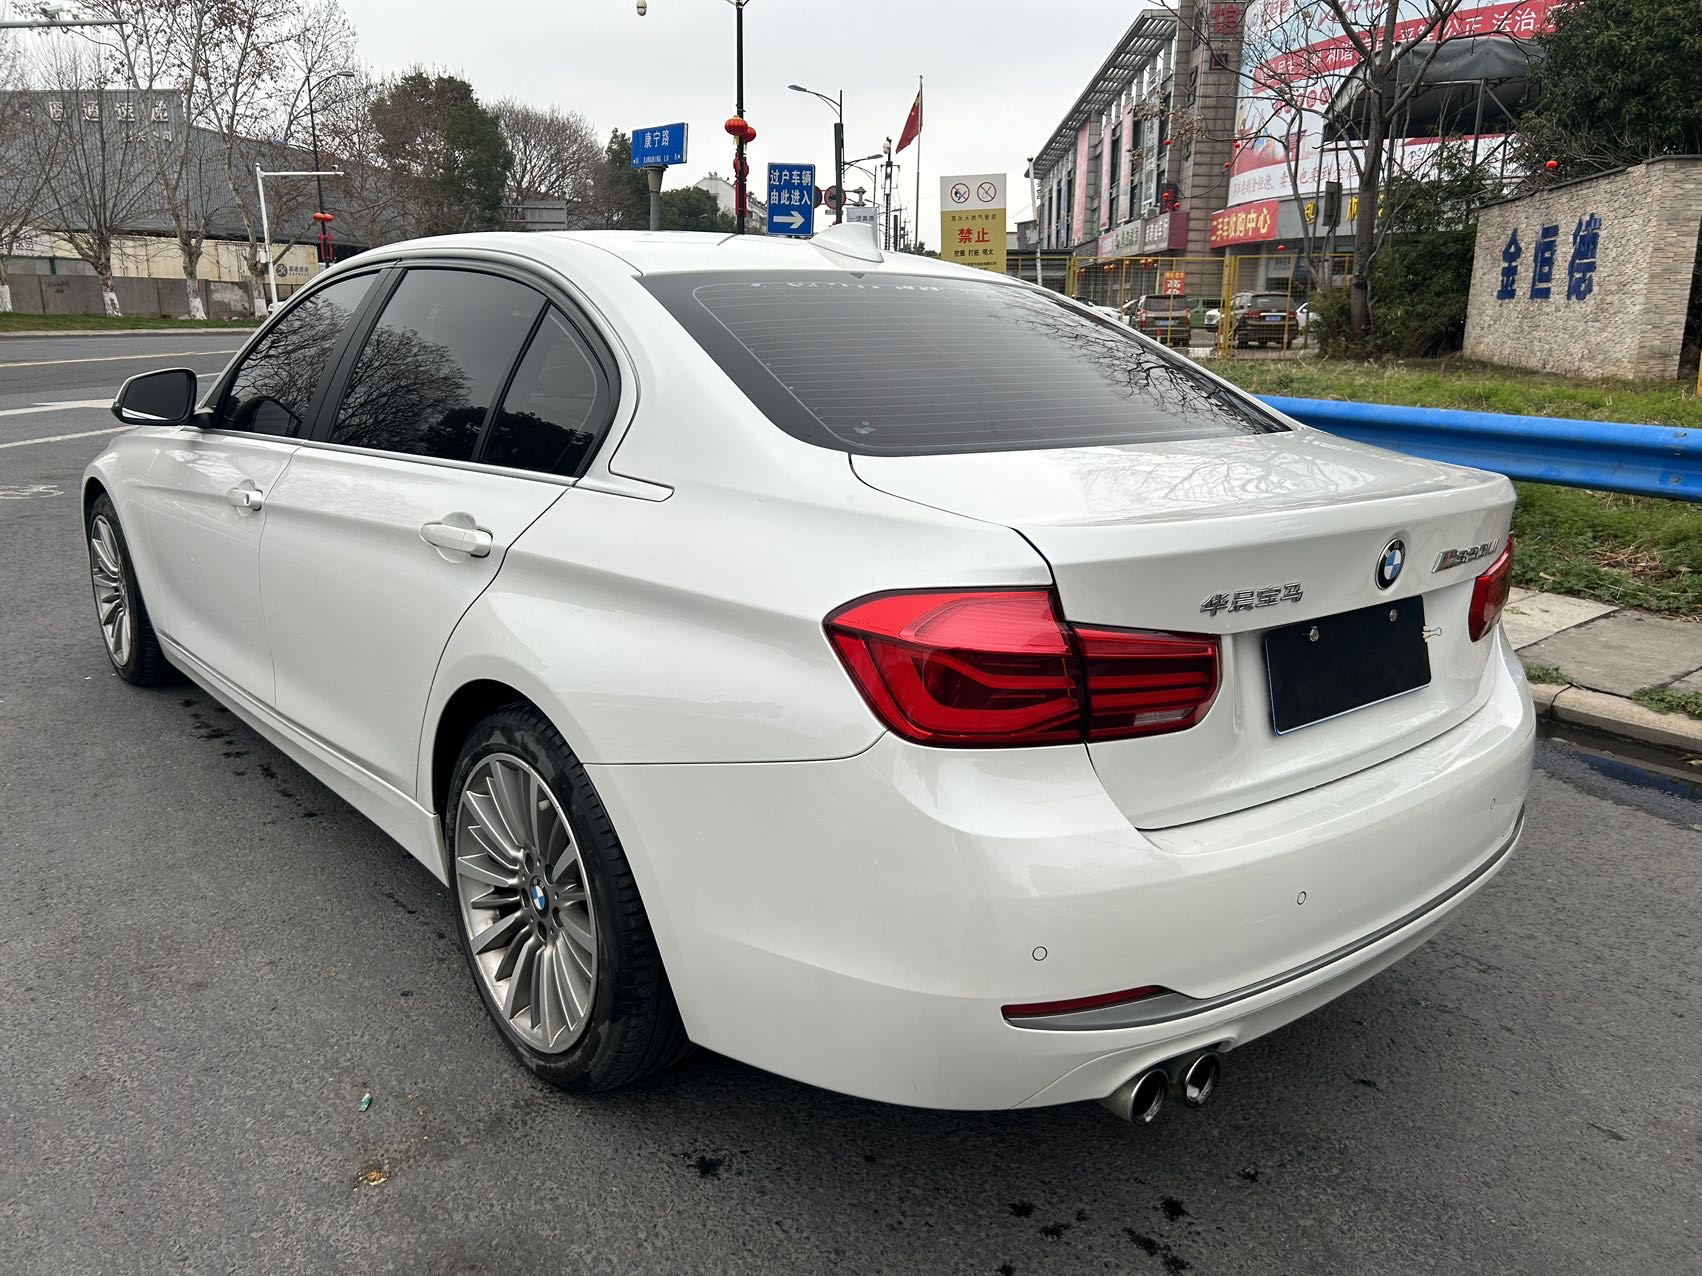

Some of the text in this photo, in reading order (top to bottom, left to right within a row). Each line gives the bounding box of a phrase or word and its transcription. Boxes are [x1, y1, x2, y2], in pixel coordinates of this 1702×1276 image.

[1443, 15, 1483, 39] 公正
[1492, 7, 1537, 34] 法治
[644, 129, 669, 149] 康宁路
[770, 169, 812, 186] 过户车辆
[770, 189, 811, 205] 由此进入
[958, 227, 990, 244] 禁止
[1211, 207, 1271, 242] 二手车收购中心
[1496, 212, 1602, 300] 金恒德
[1200, 582, 1304, 617] 华晨宝马
